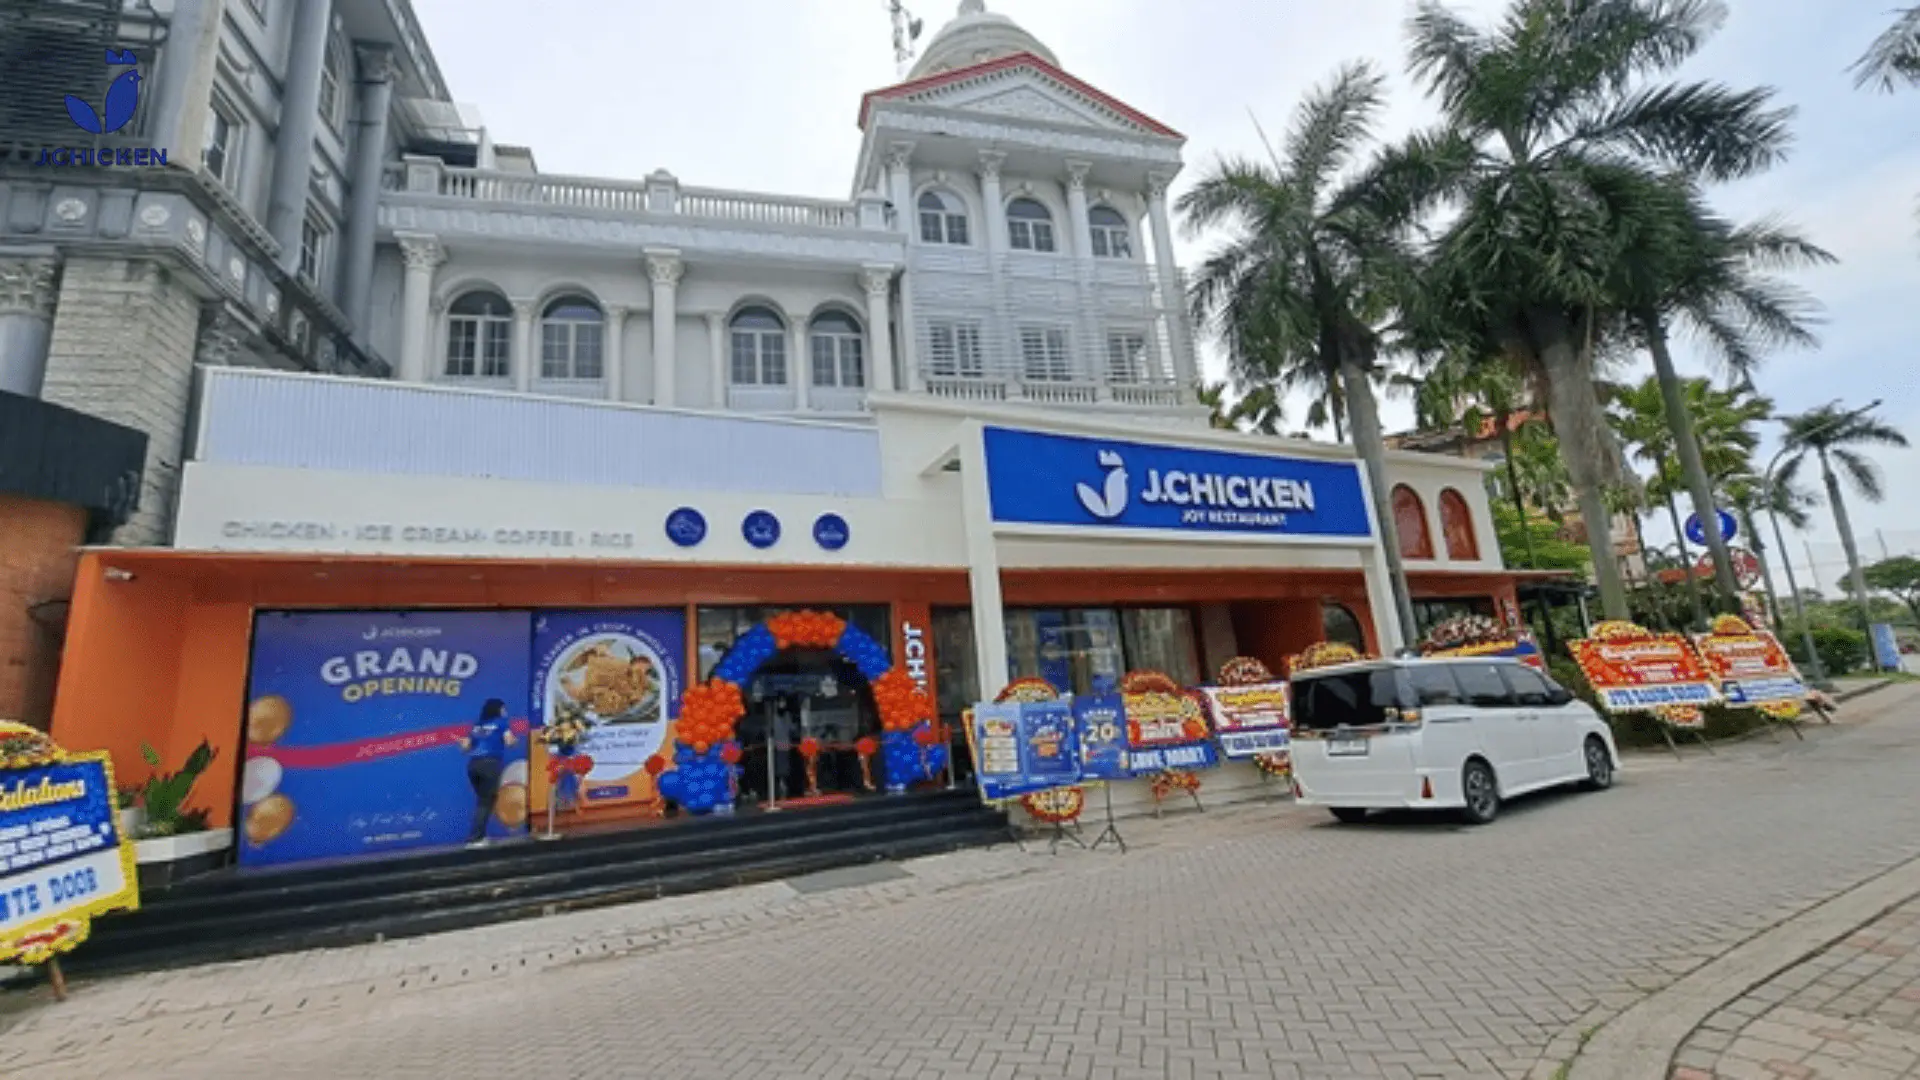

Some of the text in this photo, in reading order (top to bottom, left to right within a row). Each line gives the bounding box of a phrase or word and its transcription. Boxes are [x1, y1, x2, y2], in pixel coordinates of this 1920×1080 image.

[1141, 468, 1315, 511] J.CHICKEN
[1182, 509, 1287, 527] JOY RESTAURANT
[222, 521, 634, 548] CHICKEN ICE CREAM COFFEE RICE
[320, 647, 478, 684] GRAND
[342, 677, 463, 702] OPENING
